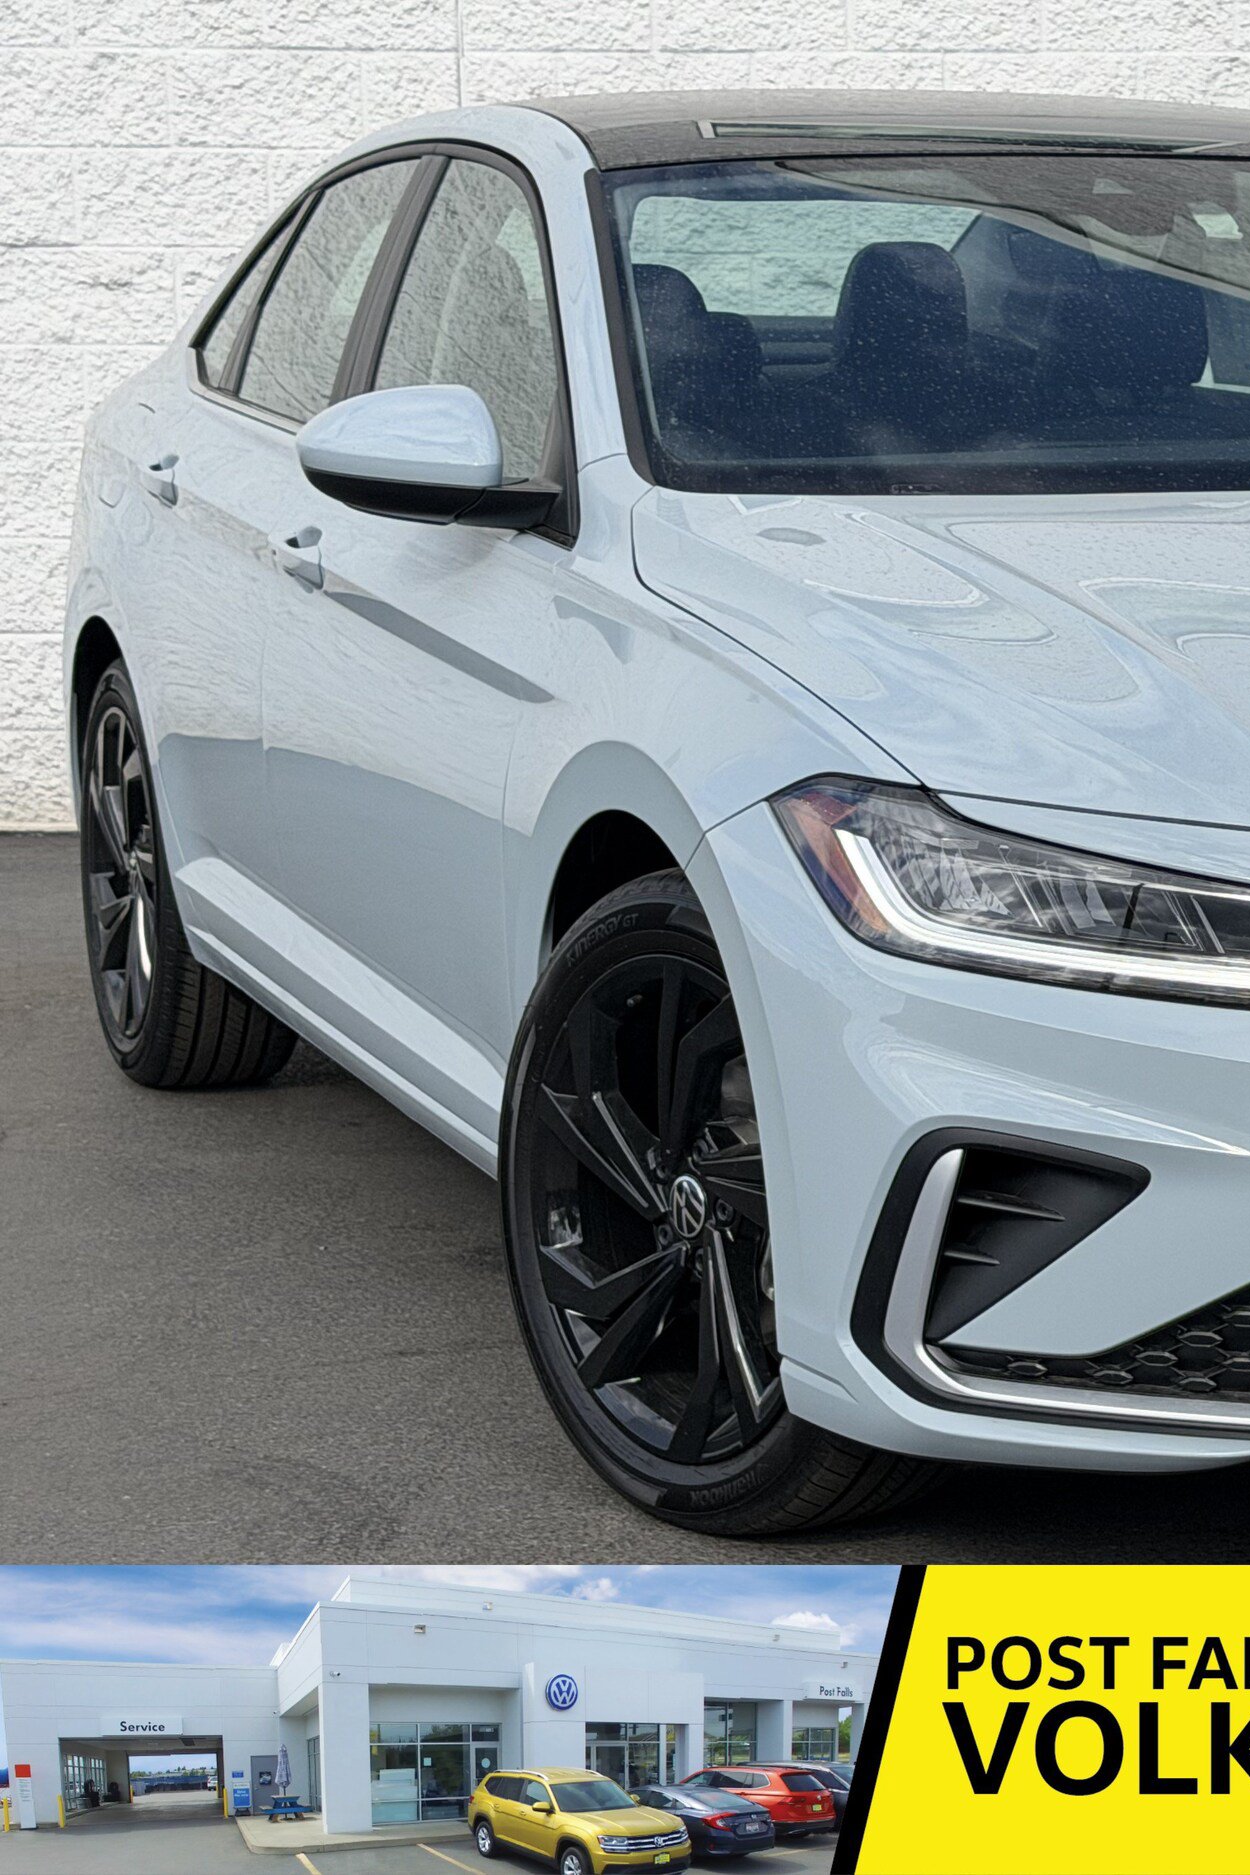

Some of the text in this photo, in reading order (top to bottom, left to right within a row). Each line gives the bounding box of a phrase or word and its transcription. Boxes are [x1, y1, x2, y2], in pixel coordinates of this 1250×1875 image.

[819, 1685, 853, 1698] Post Falls
[120, 1721, 165, 1732] Service
